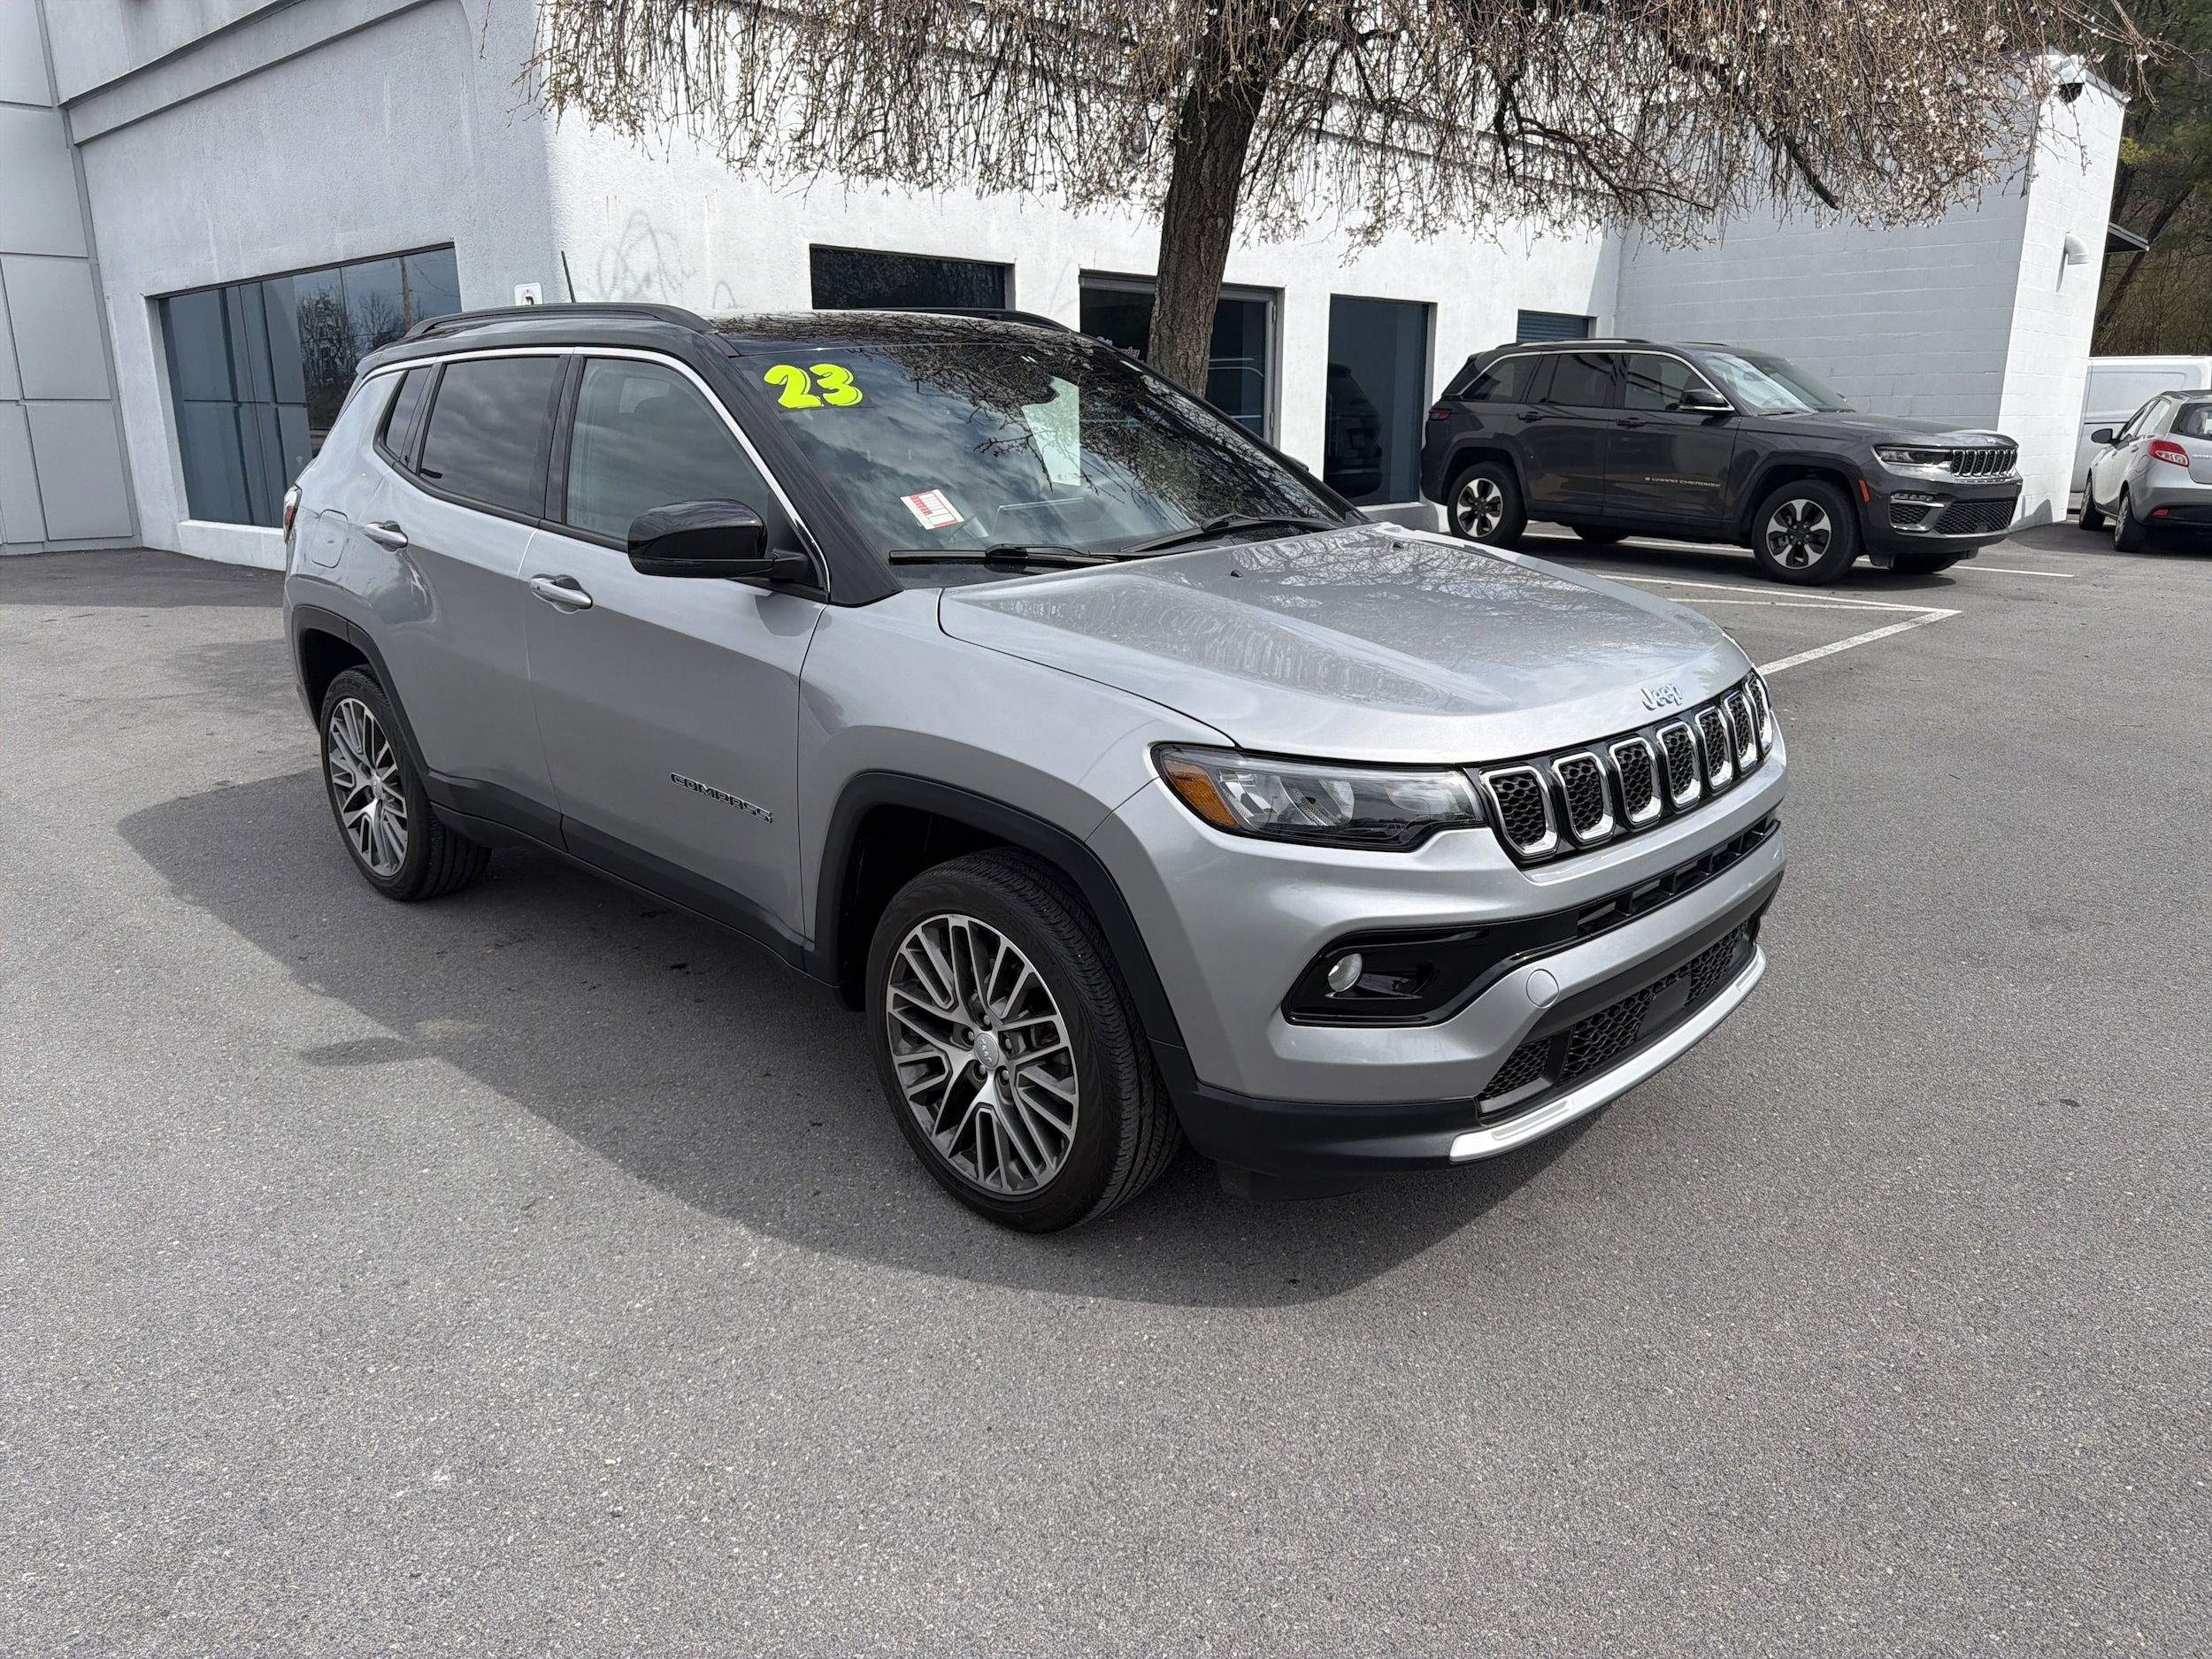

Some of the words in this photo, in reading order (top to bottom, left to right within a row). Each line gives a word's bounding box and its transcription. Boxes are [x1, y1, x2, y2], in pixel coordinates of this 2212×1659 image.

[763, 363, 864, 409] 23
[1640, 684, 1683, 710] Jeep
[670, 772, 773, 824] COMPASS
